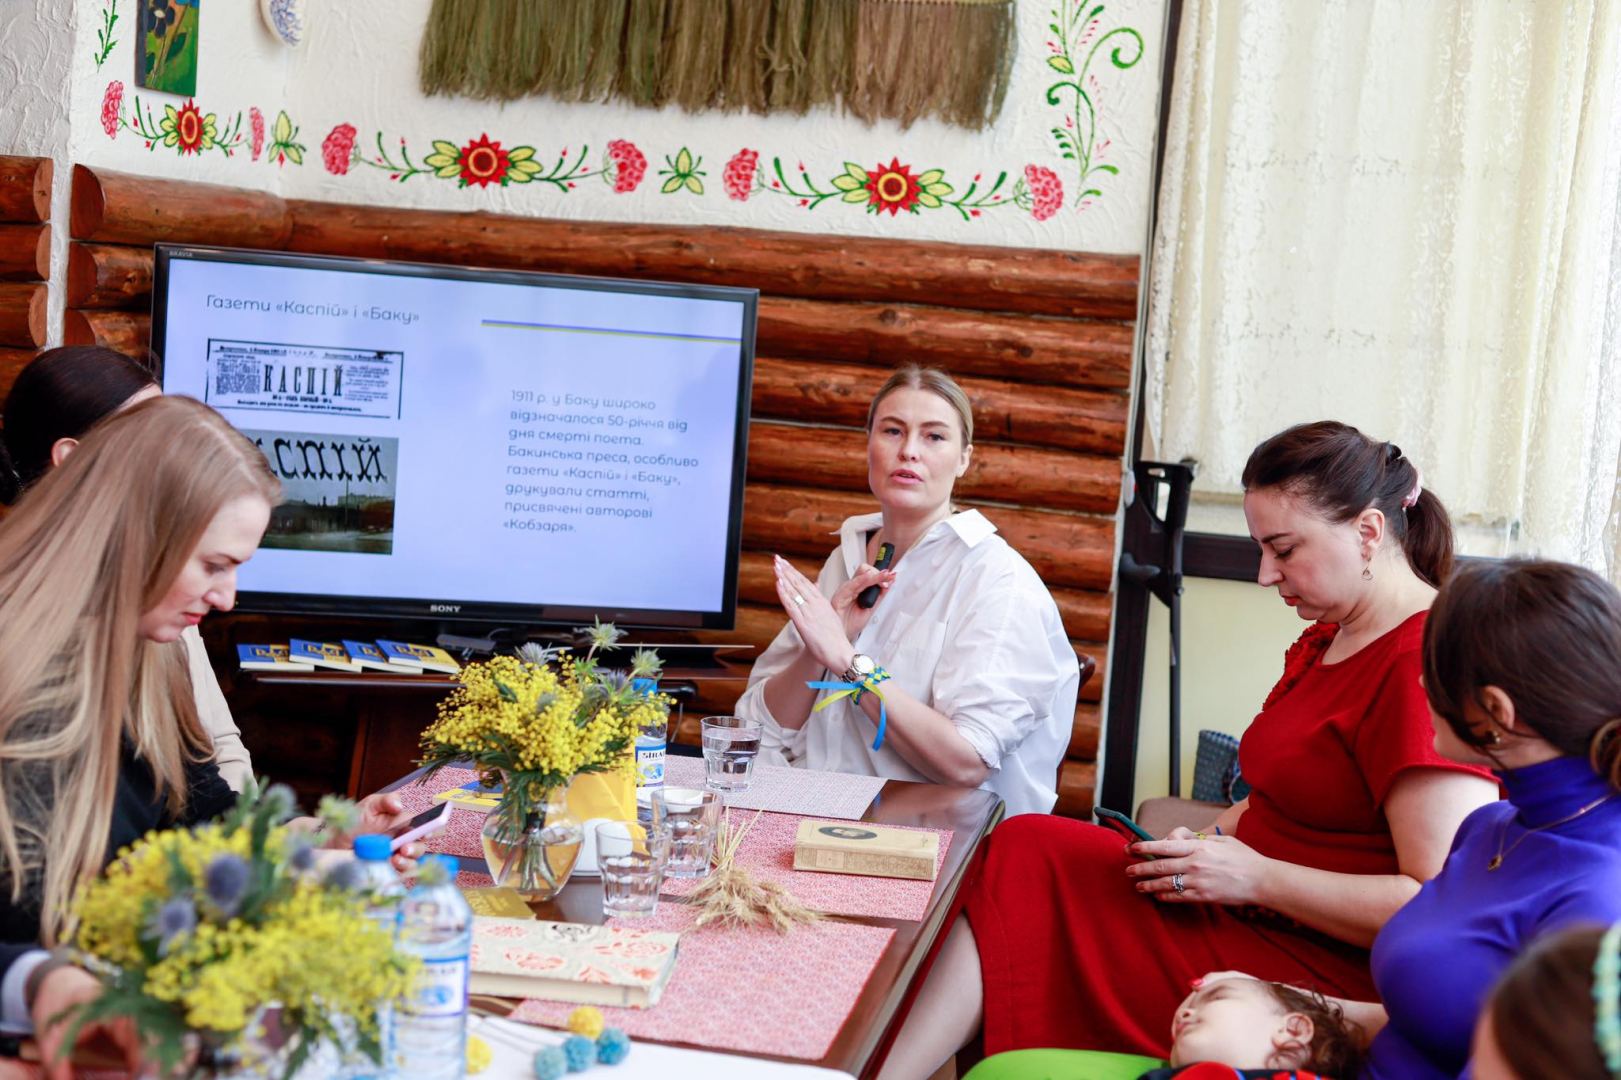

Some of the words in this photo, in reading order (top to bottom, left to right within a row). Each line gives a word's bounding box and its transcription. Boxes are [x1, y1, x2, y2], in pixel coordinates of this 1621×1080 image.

[206, 294, 271, 312] Газети
[276, 299, 349, 318] «Каспій»
[353, 304, 358, 318] і
[362, 306, 420, 325] «Баку»
[263, 363, 344, 397] КАСПІЙ
[511, 389, 534, 402] 1911
[552, 394, 561, 406] у
[565, 393, 599, 409] Баку
[603, 399, 656, 411] широко
[510, 409, 604, 425] відзначалося
[607, 415, 664, 430] 50-річчя
[667, 419, 688, 433] від
[508, 429, 535, 441] дня
[538, 430, 591, 445] смерті
[594, 433, 644, 446] поета.
[508, 445, 583, 461] Бакинська
[587, 452, 631, 465] преса,
[634, 453, 699, 467] особливо
[506, 464, 559, 478] газети
[563, 467, 621, 481] «Каспій»
[632, 470, 681, 486] «Баку»,
[505, 483, 583, 497] друкували
[585, 487, 650, 502] статті,
[504, 501, 583, 515] присвячені
[585, 505, 653, 519] авторові
[502, 519, 576, 534] «Кобзаря».
[430, 604, 462, 613] SONY
